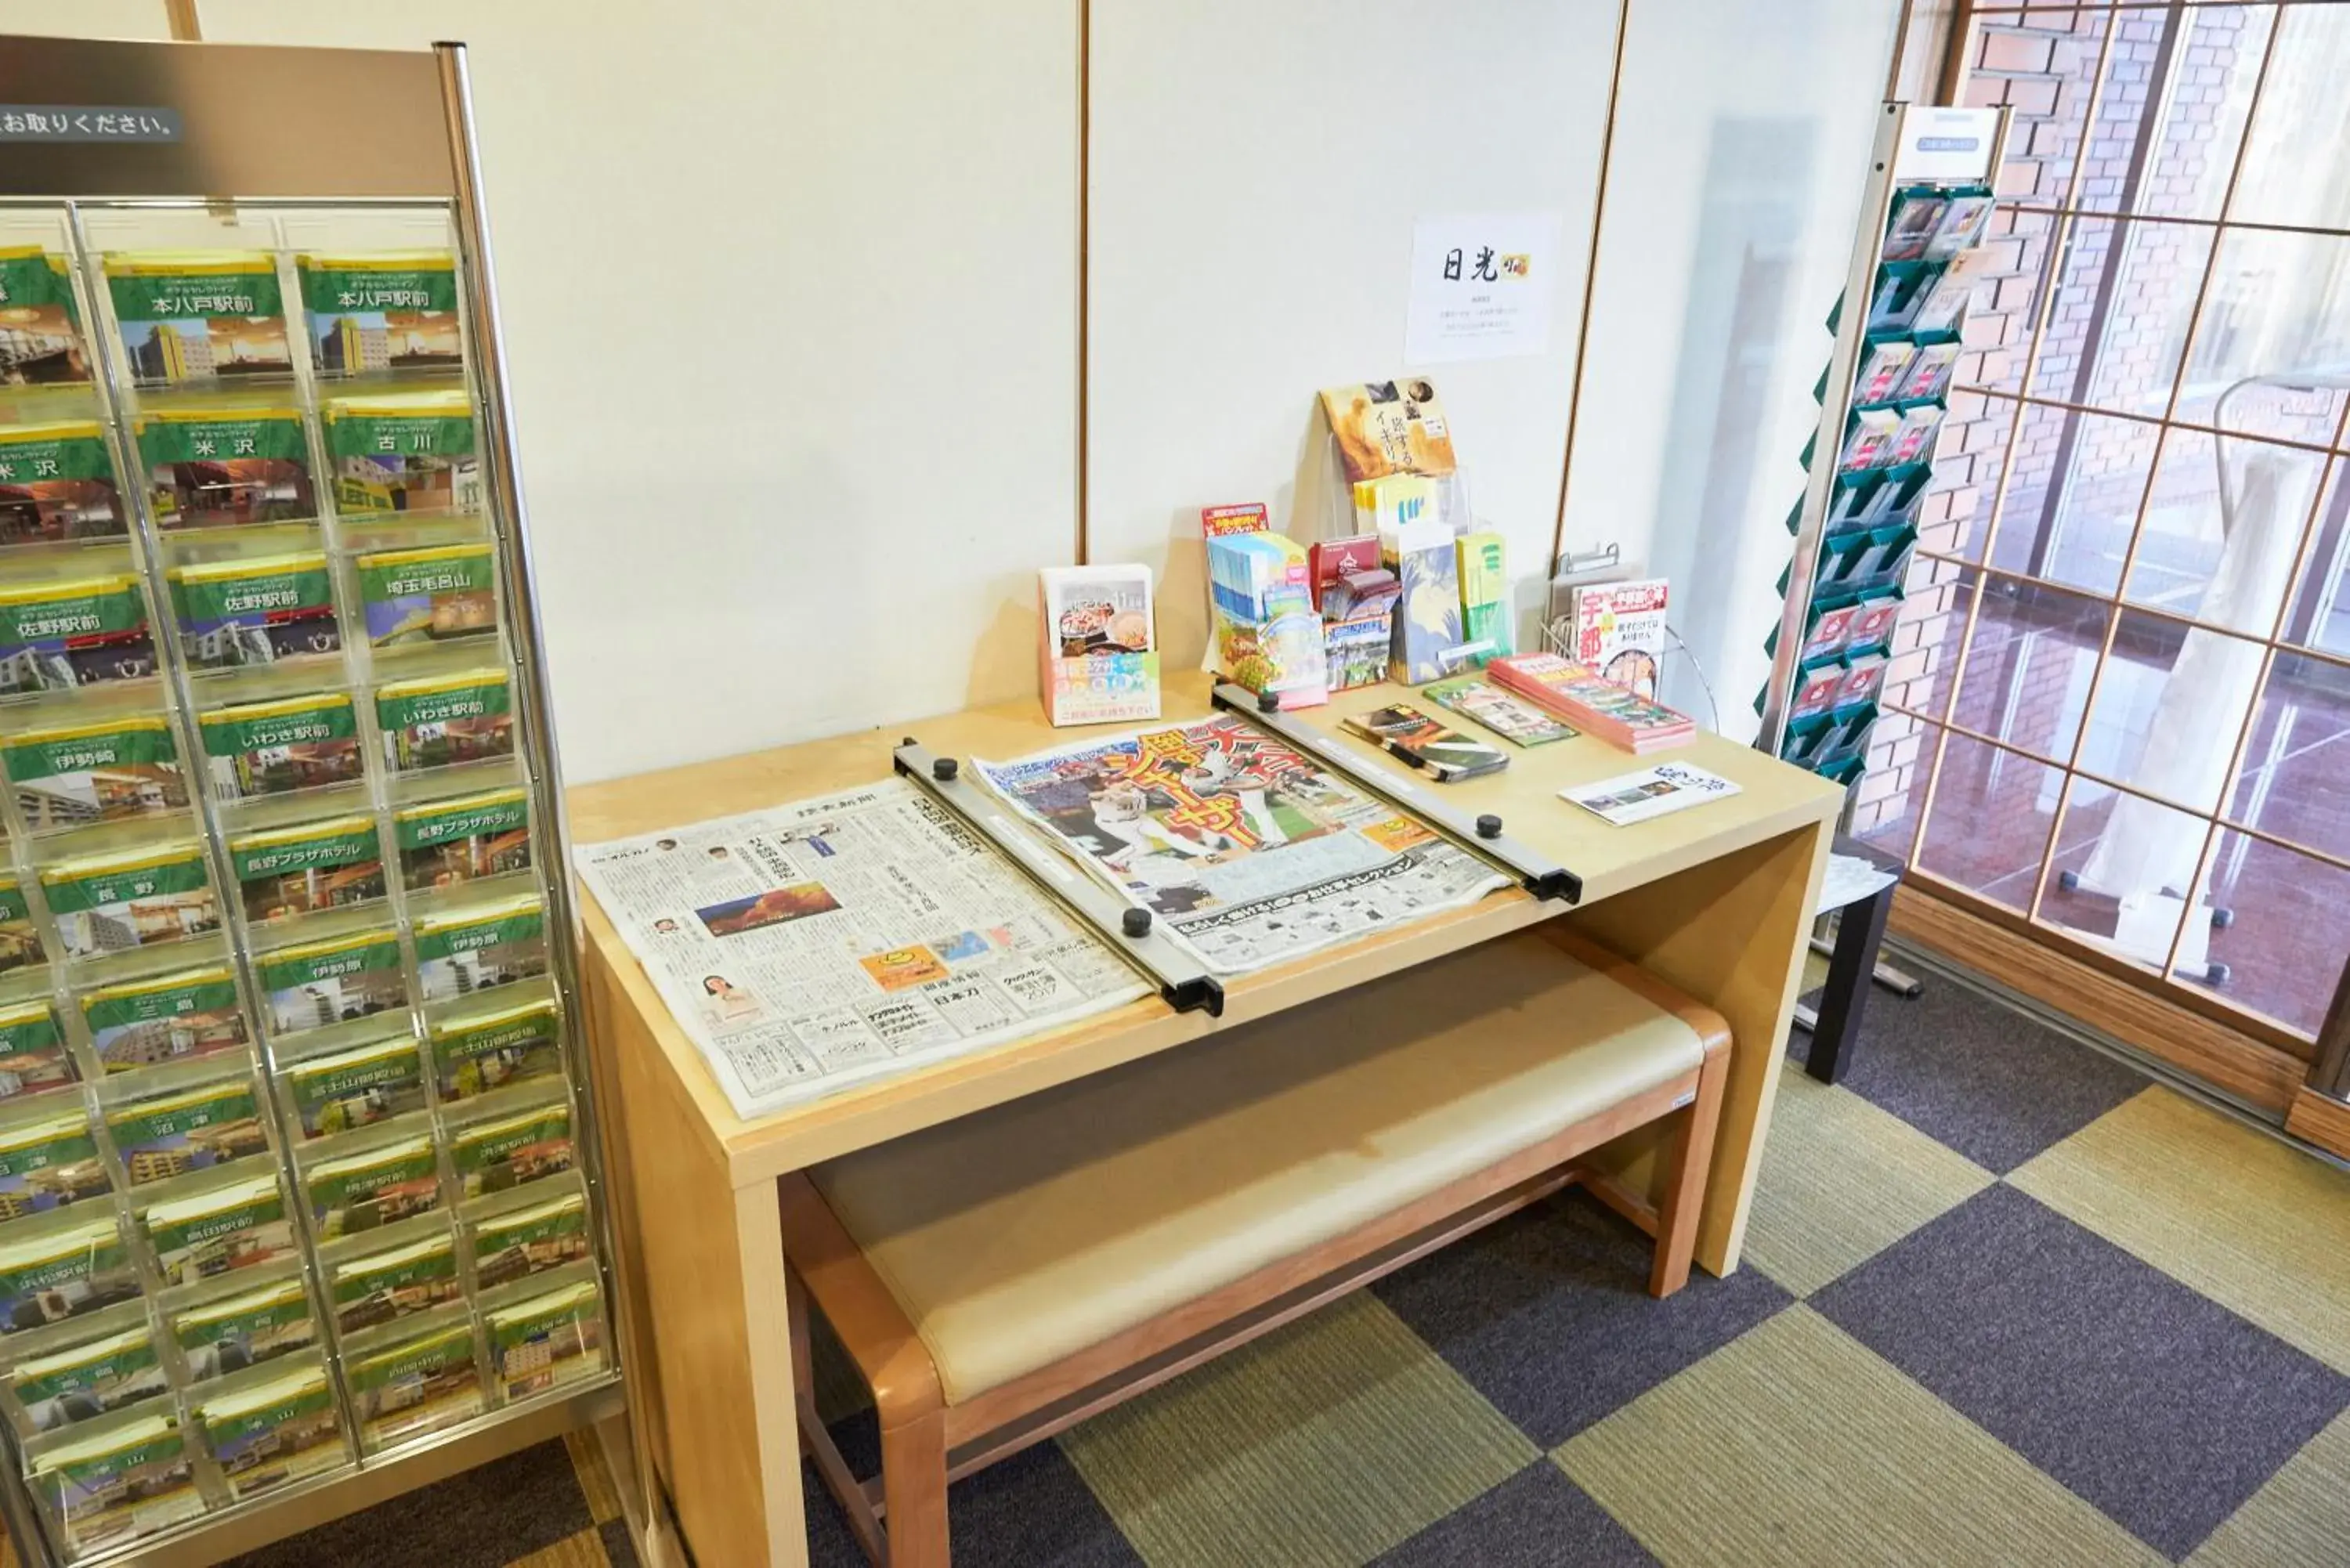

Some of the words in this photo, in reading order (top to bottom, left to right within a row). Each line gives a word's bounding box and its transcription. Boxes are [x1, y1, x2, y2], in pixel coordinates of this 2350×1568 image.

[0, 113, 170, 134] お取りください。
[151, 295, 254, 313] 本八戸駅前
[338, 291, 429, 307] 本八戸駅前
[193, 439, 255, 457] 米沢
[378, 433, 431, 451] 古川
[224, 590, 298, 612] 佐野駅前
[17, 614, 100, 638] 佐野駅前
[1580, 591, 1603, 667] 宇都
[403, 701, 483, 724] いわき駅前
[241, 724, 331, 748] いわき駅前
[248, 844, 361, 873] 長野プラザホテル
